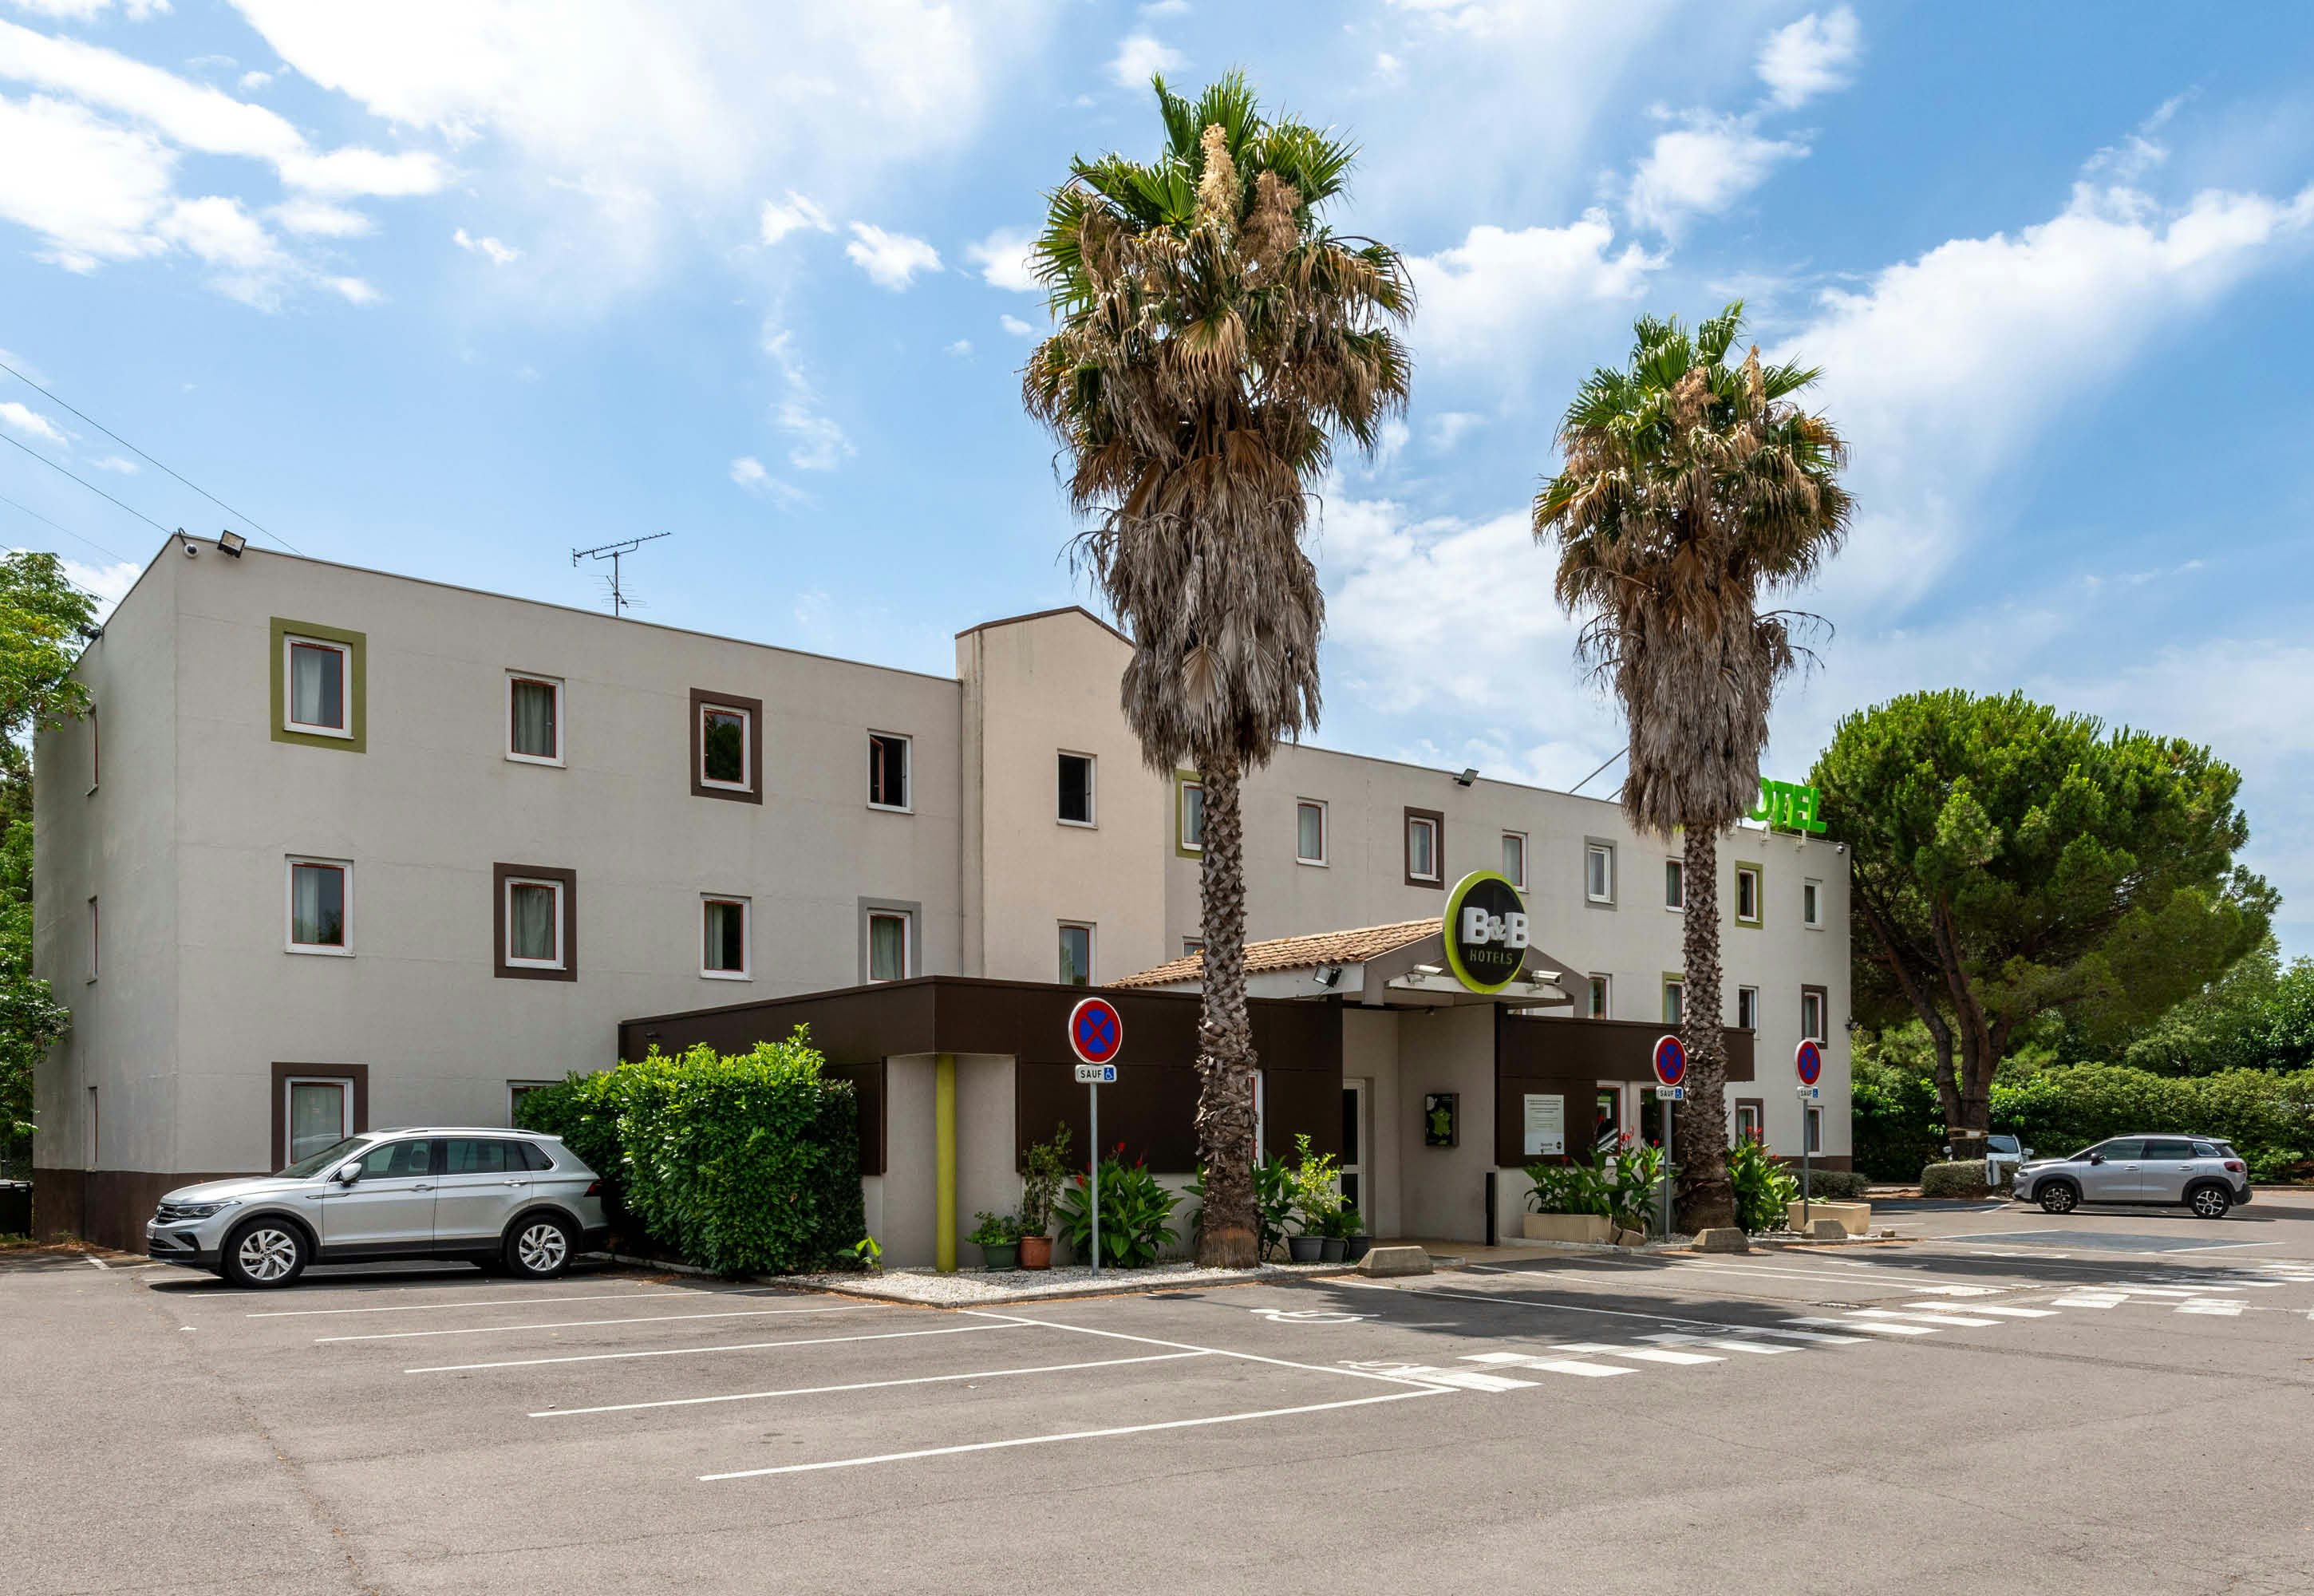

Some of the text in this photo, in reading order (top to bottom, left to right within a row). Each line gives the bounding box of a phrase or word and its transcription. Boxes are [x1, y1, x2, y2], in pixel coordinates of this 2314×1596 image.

[1743, 777, 1826, 833] OTEL
[1463, 907, 1530, 949] B&B
[1470, 949, 1513, 965] HOTELS
